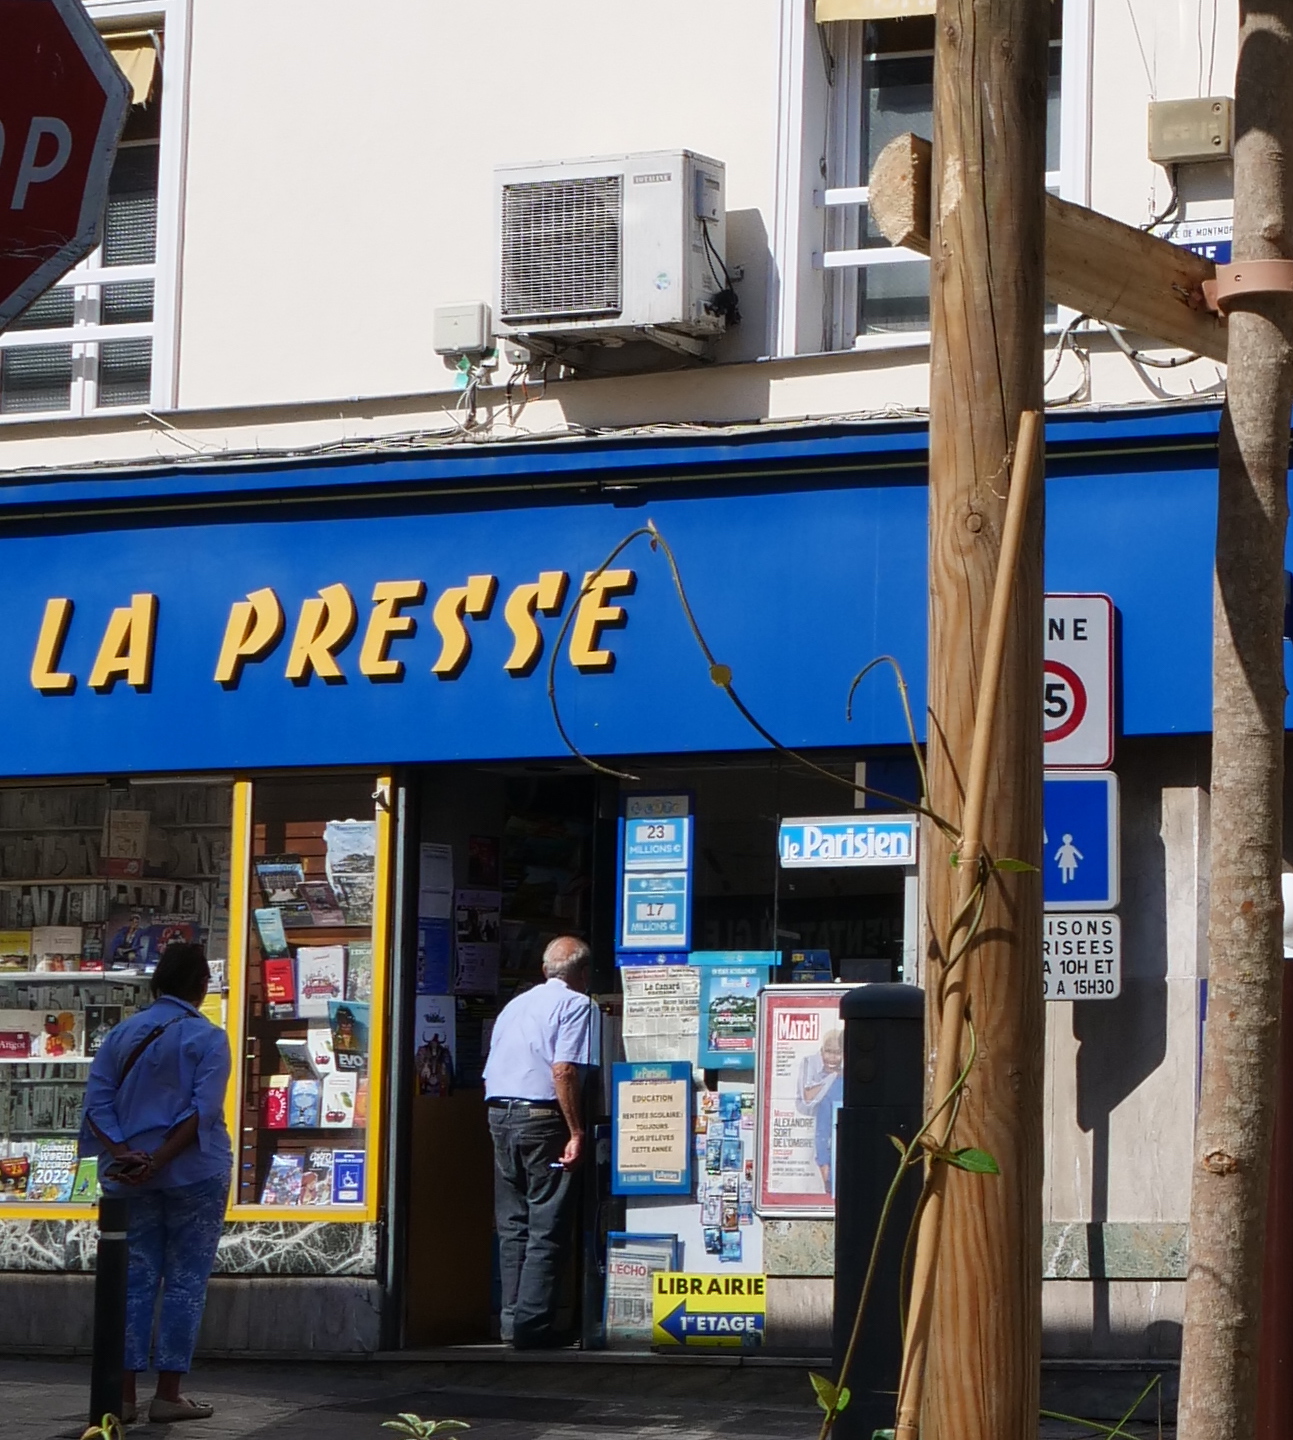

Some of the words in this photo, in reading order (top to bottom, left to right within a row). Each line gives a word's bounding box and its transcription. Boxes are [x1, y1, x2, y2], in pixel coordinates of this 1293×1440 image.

[1183, 228, 1193, 238] DE
[31, 592, 157, 692] LA
[214, 569, 638, 688] PRESSE
[646, 825, 665, 839] 23
[629, 844, 673, 855] MILLIONS
[782, 834, 800, 860] le
[803, 825, 910, 860] Parisien
[646, 903, 664, 917] 17
[630, 922, 668, 932] MILLIONS
[1059, 960, 1088, 975] 10H
[1095, 959, 1114, 974] ET
[644, 983, 653, 991] Le
[655, 982, 681, 991] Canard
[1056, 980, 1066, 995] A
[1073, 980, 1114, 995] 15H30
[636, 1123, 669, 1131] TOUJOURS
[774, 1117, 814, 1128] ALEXANDRE
[774, 1128, 791, 1138] SORT
[773, 1138, 782, 1148] DE
[34, 1169, 70, 1184] 2022
[608, 1263, 647, 1277] L'ECHO
[657, 1277, 764, 1296] LIBRAIRIE
[680, 1316, 695, 1331] 1er
[697, 1315, 756, 1331] ETAGE
